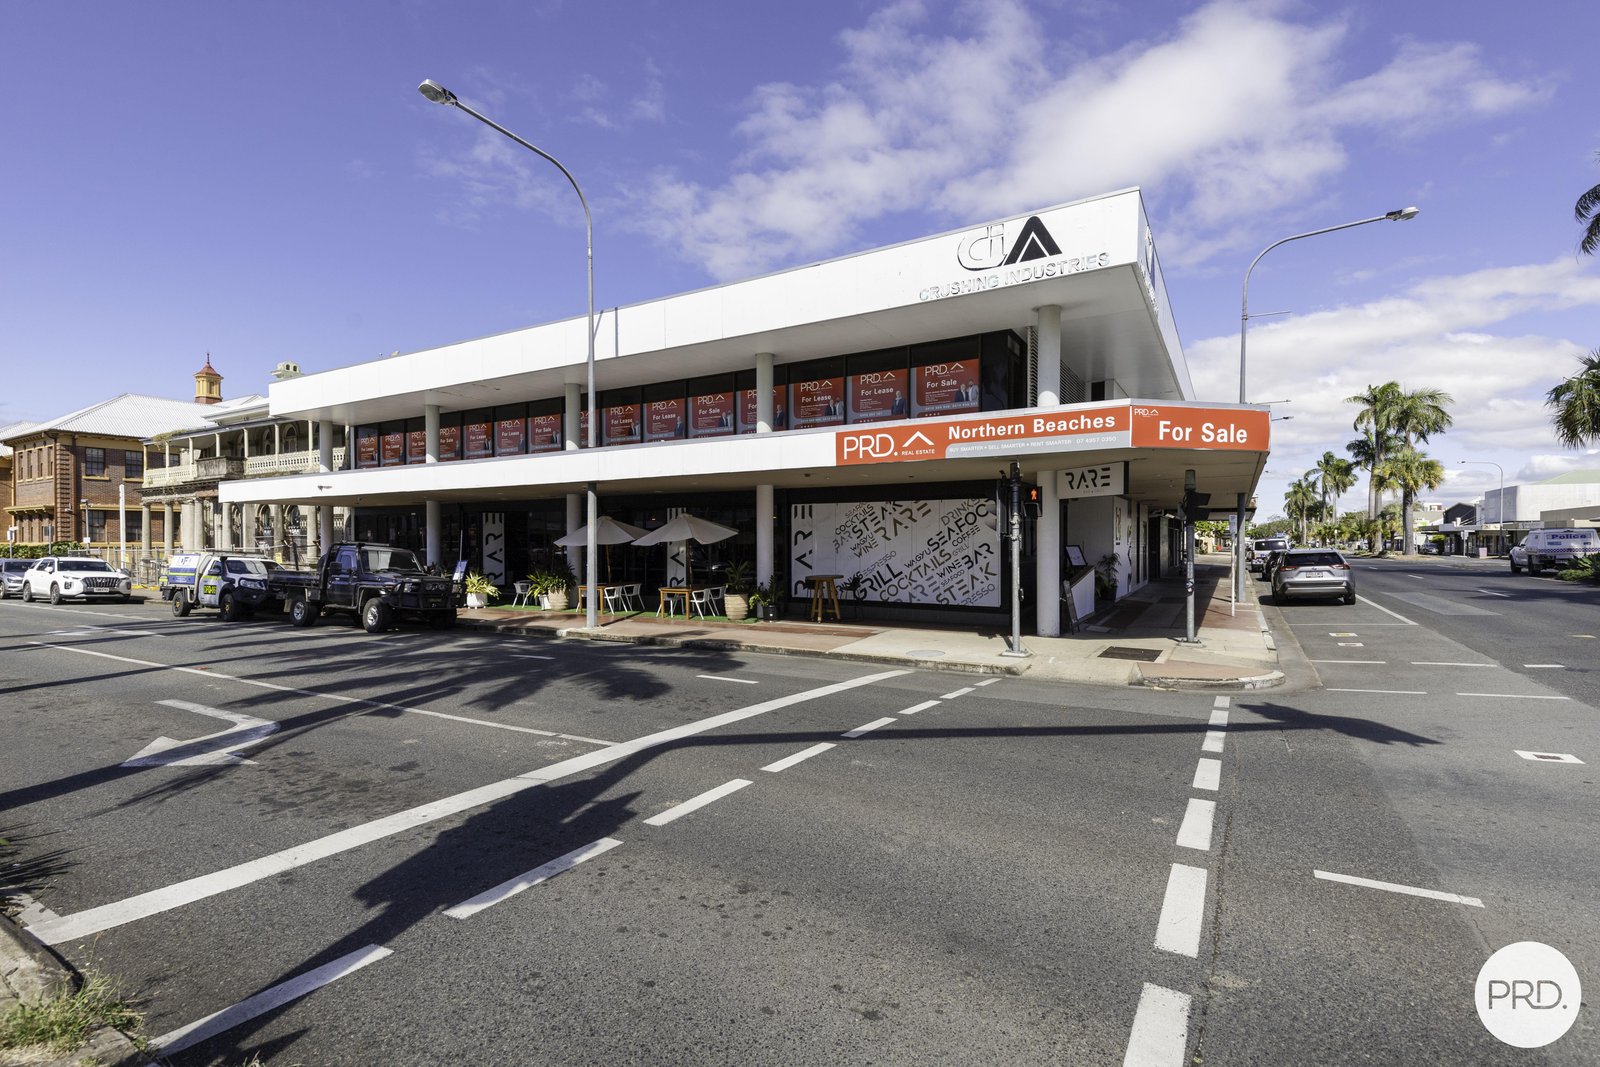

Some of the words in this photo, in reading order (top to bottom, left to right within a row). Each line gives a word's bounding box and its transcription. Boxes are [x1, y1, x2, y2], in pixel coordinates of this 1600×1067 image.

[919, 274, 1000, 302] CRUSHING
[1004, 252, 1110, 286] INDUSTRIES
[747, 390, 757, 399] PR
[948, 423, 1025, 440] Northern
[1033, 415, 1116, 434] Beaches
[1159, 420, 1192, 441] For
[1201, 422, 1248, 443] Sale
[1065, 467, 1110, 490] RARE
[835, 504, 874, 535] COCKTAILS
[873, 500, 931, 541] RARE
[941, 499, 980, 526] DRINKS
[833, 530, 852, 554] BAR
[852, 500, 902, 539] STEAK
[952, 525, 980, 546] COFFEE
[850, 532, 874, 551] WAGYU
[854, 538, 879, 558] WINE
[863, 551, 896, 576] ESPRESSO
[904, 548, 931, 568] WAGYU
[936, 559, 962, 578] WINE
[962, 543, 994, 569] BAR
[854, 564, 903, 600] GRILL
[880, 549, 952, 602] COCKTAILS
[936, 562, 997, 604] STEAK
[941, 570, 964, 586] SEAFOOD
[896, 576, 940, 604] ARE
